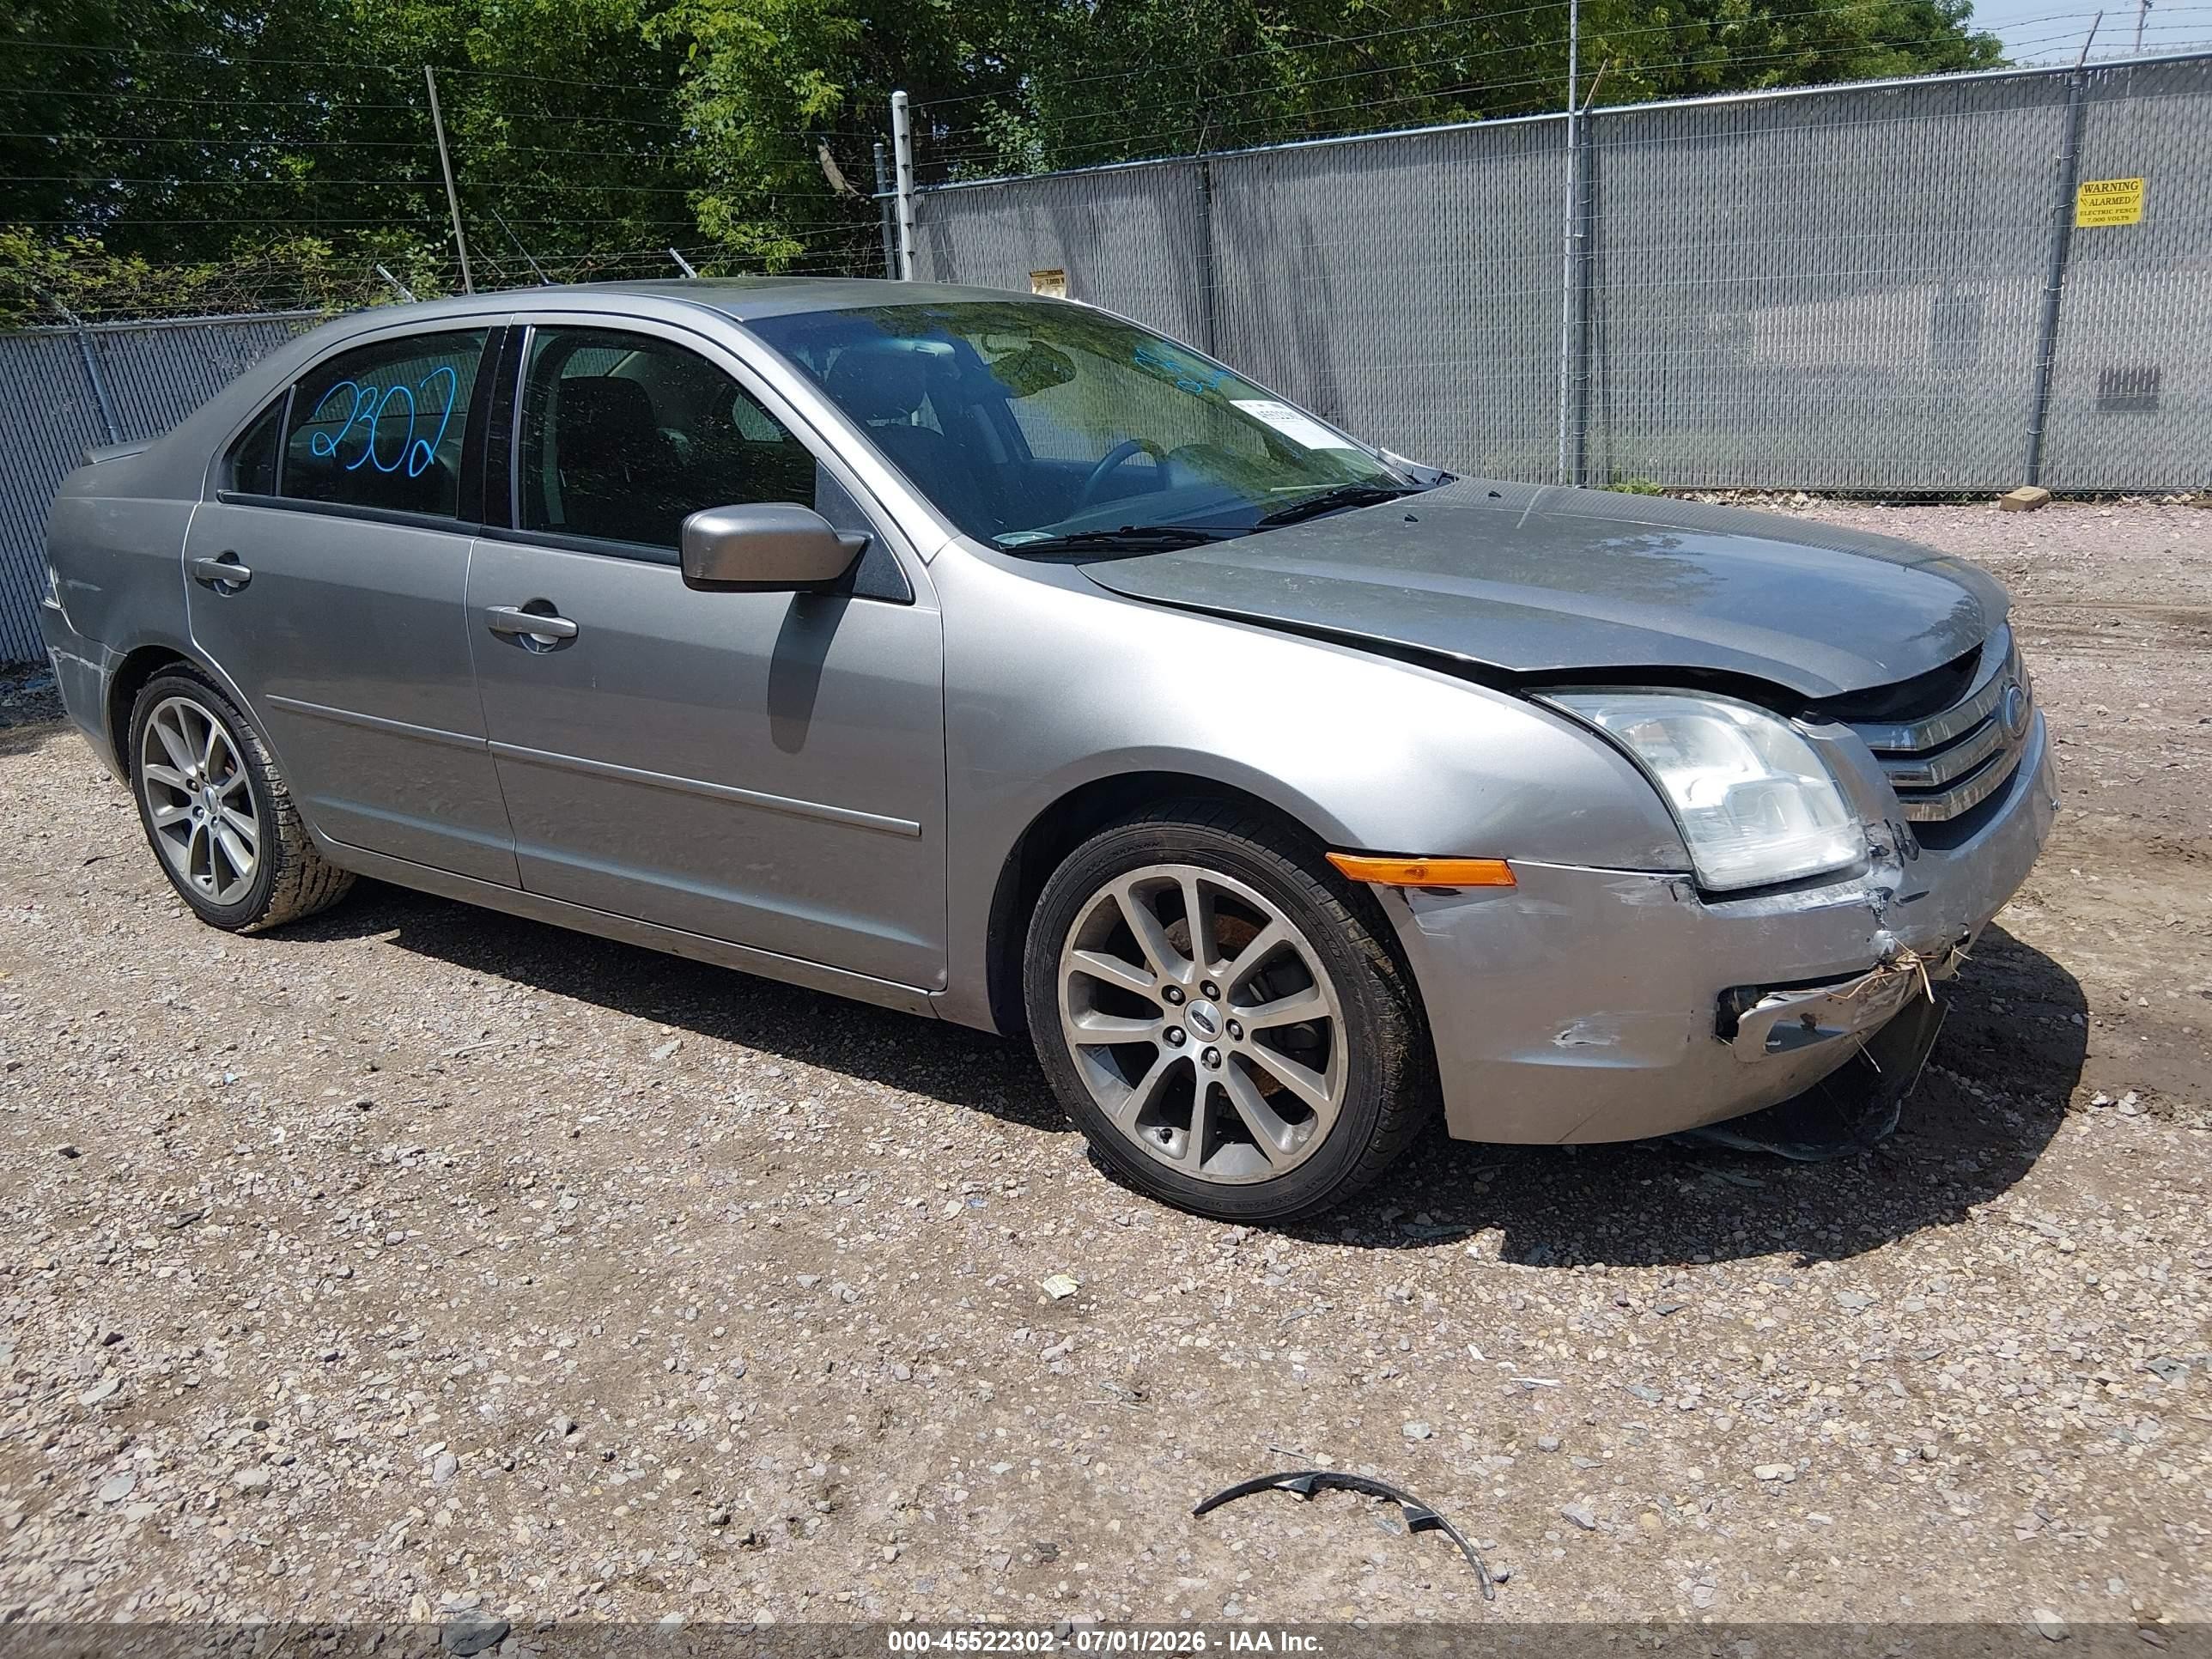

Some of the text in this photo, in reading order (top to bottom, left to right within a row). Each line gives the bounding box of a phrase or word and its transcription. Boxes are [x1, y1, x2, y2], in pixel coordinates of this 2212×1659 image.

[2084, 181, 2139, 194] WARNING
[2089, 196, 2130, 206] ALARMED
[312, 367, 457, 478] 2302
